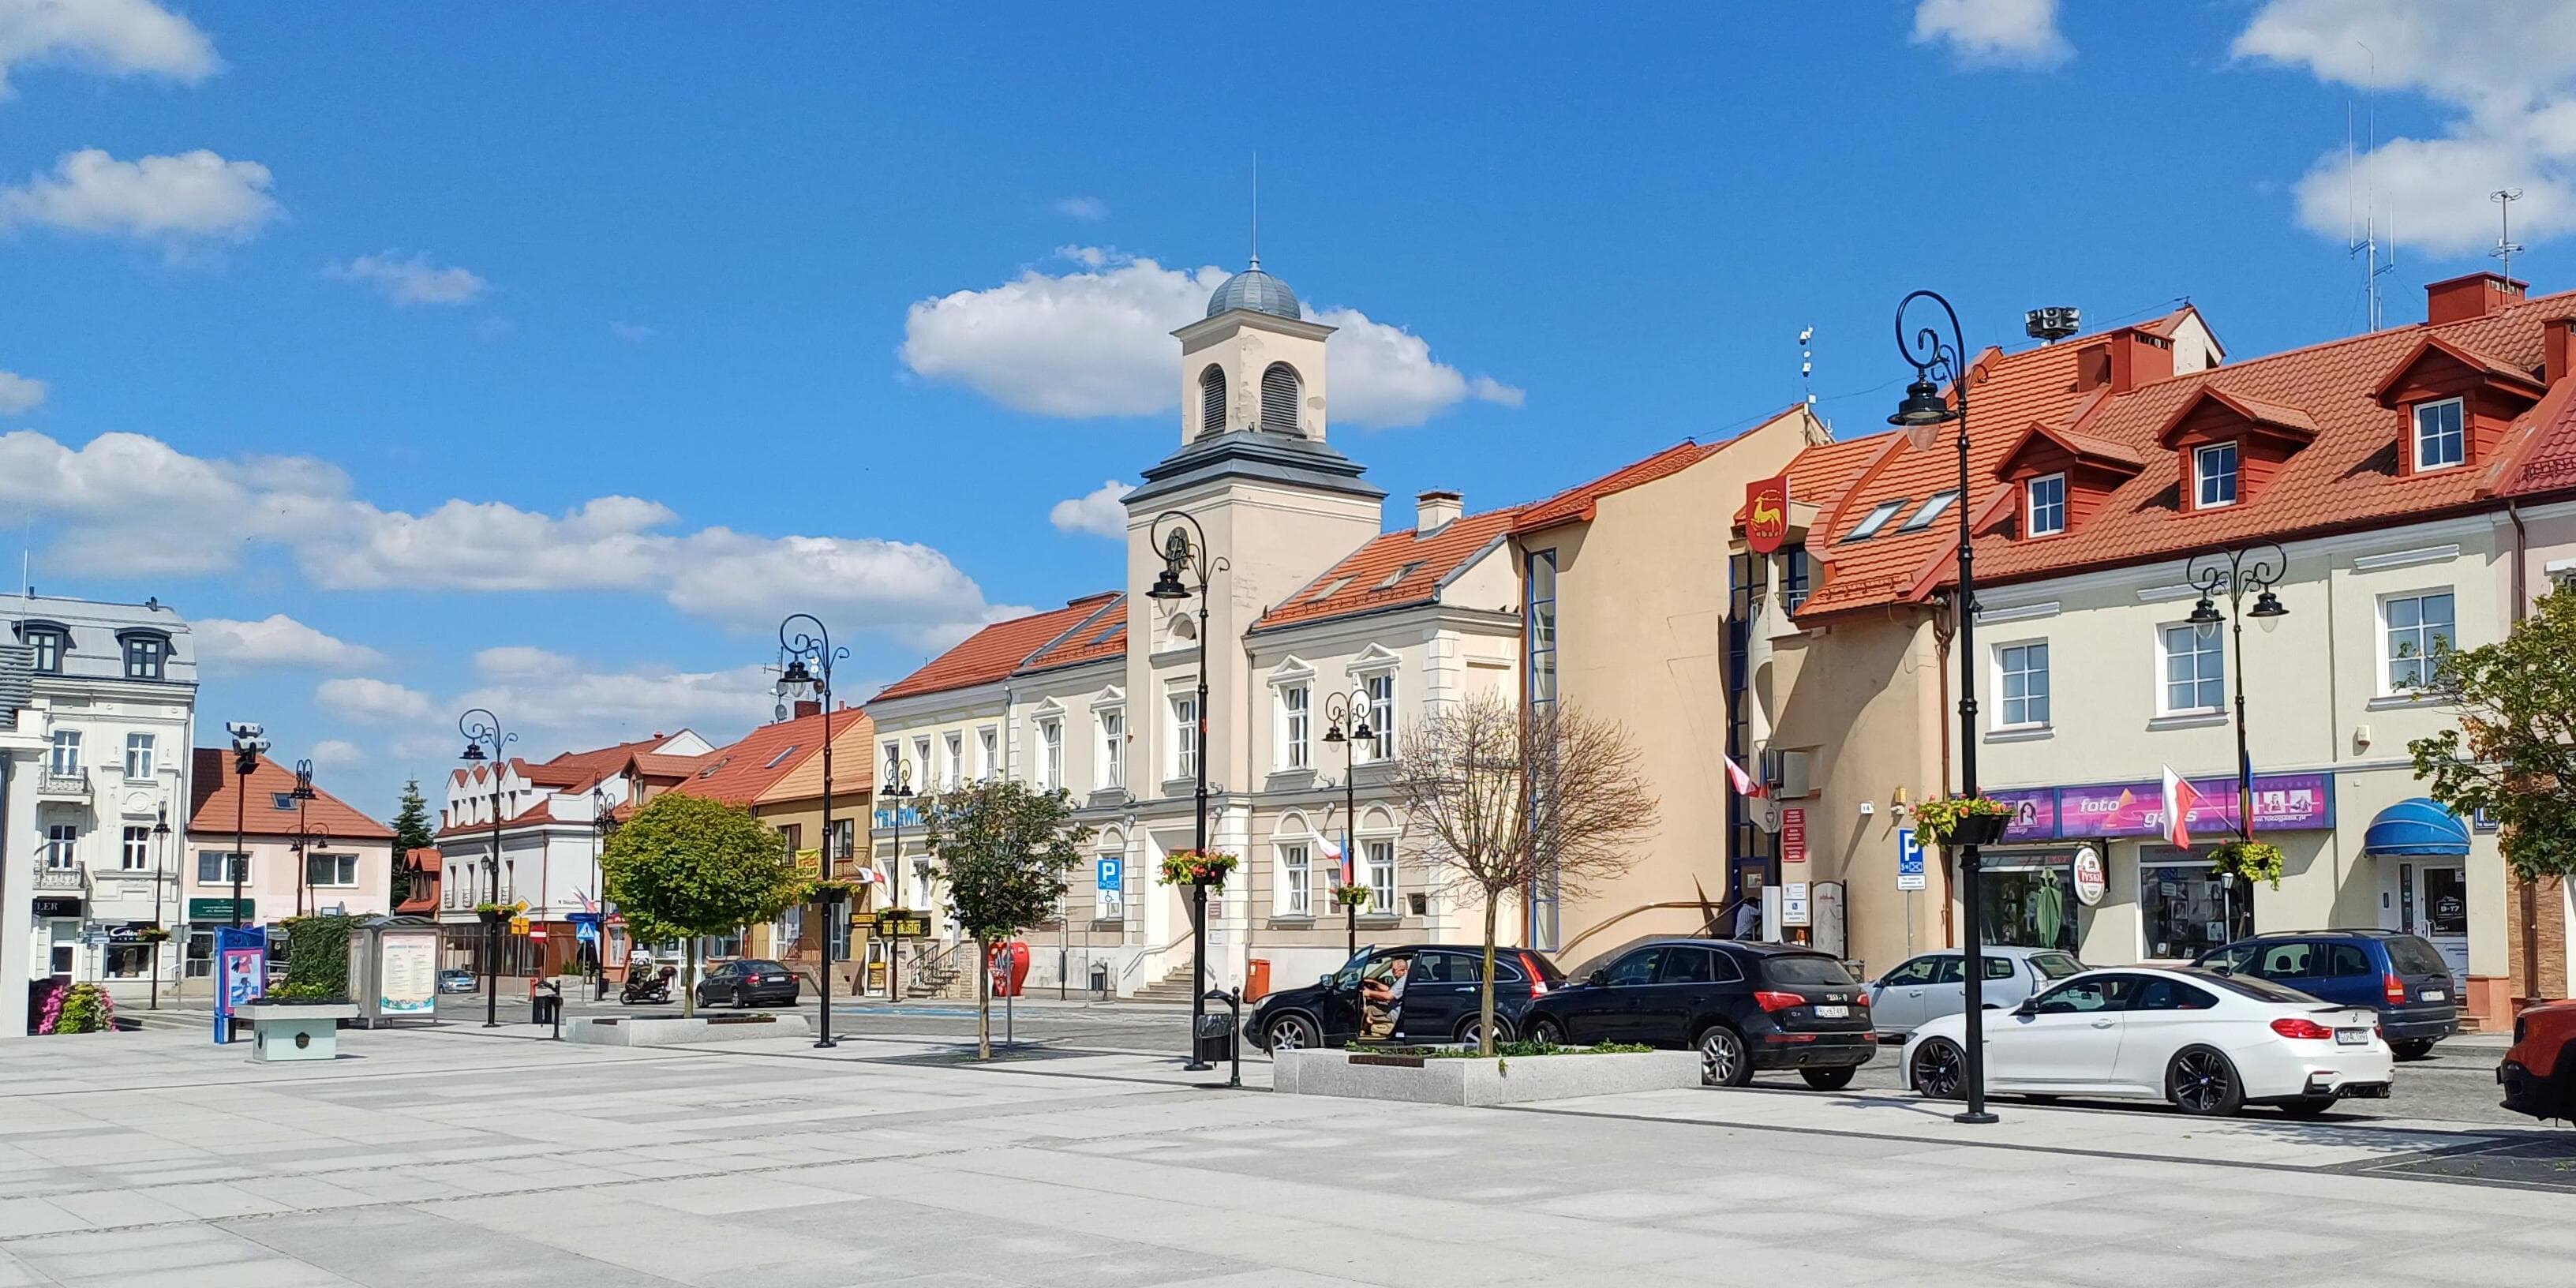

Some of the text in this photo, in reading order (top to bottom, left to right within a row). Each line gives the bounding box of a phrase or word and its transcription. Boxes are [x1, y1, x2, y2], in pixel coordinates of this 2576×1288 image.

[2080, 799, 2119, 812] foto
[1904, 833, 1919, 861] P
[1103, 862, 1116, 882] P
[34, 902, 58, 911] LER
